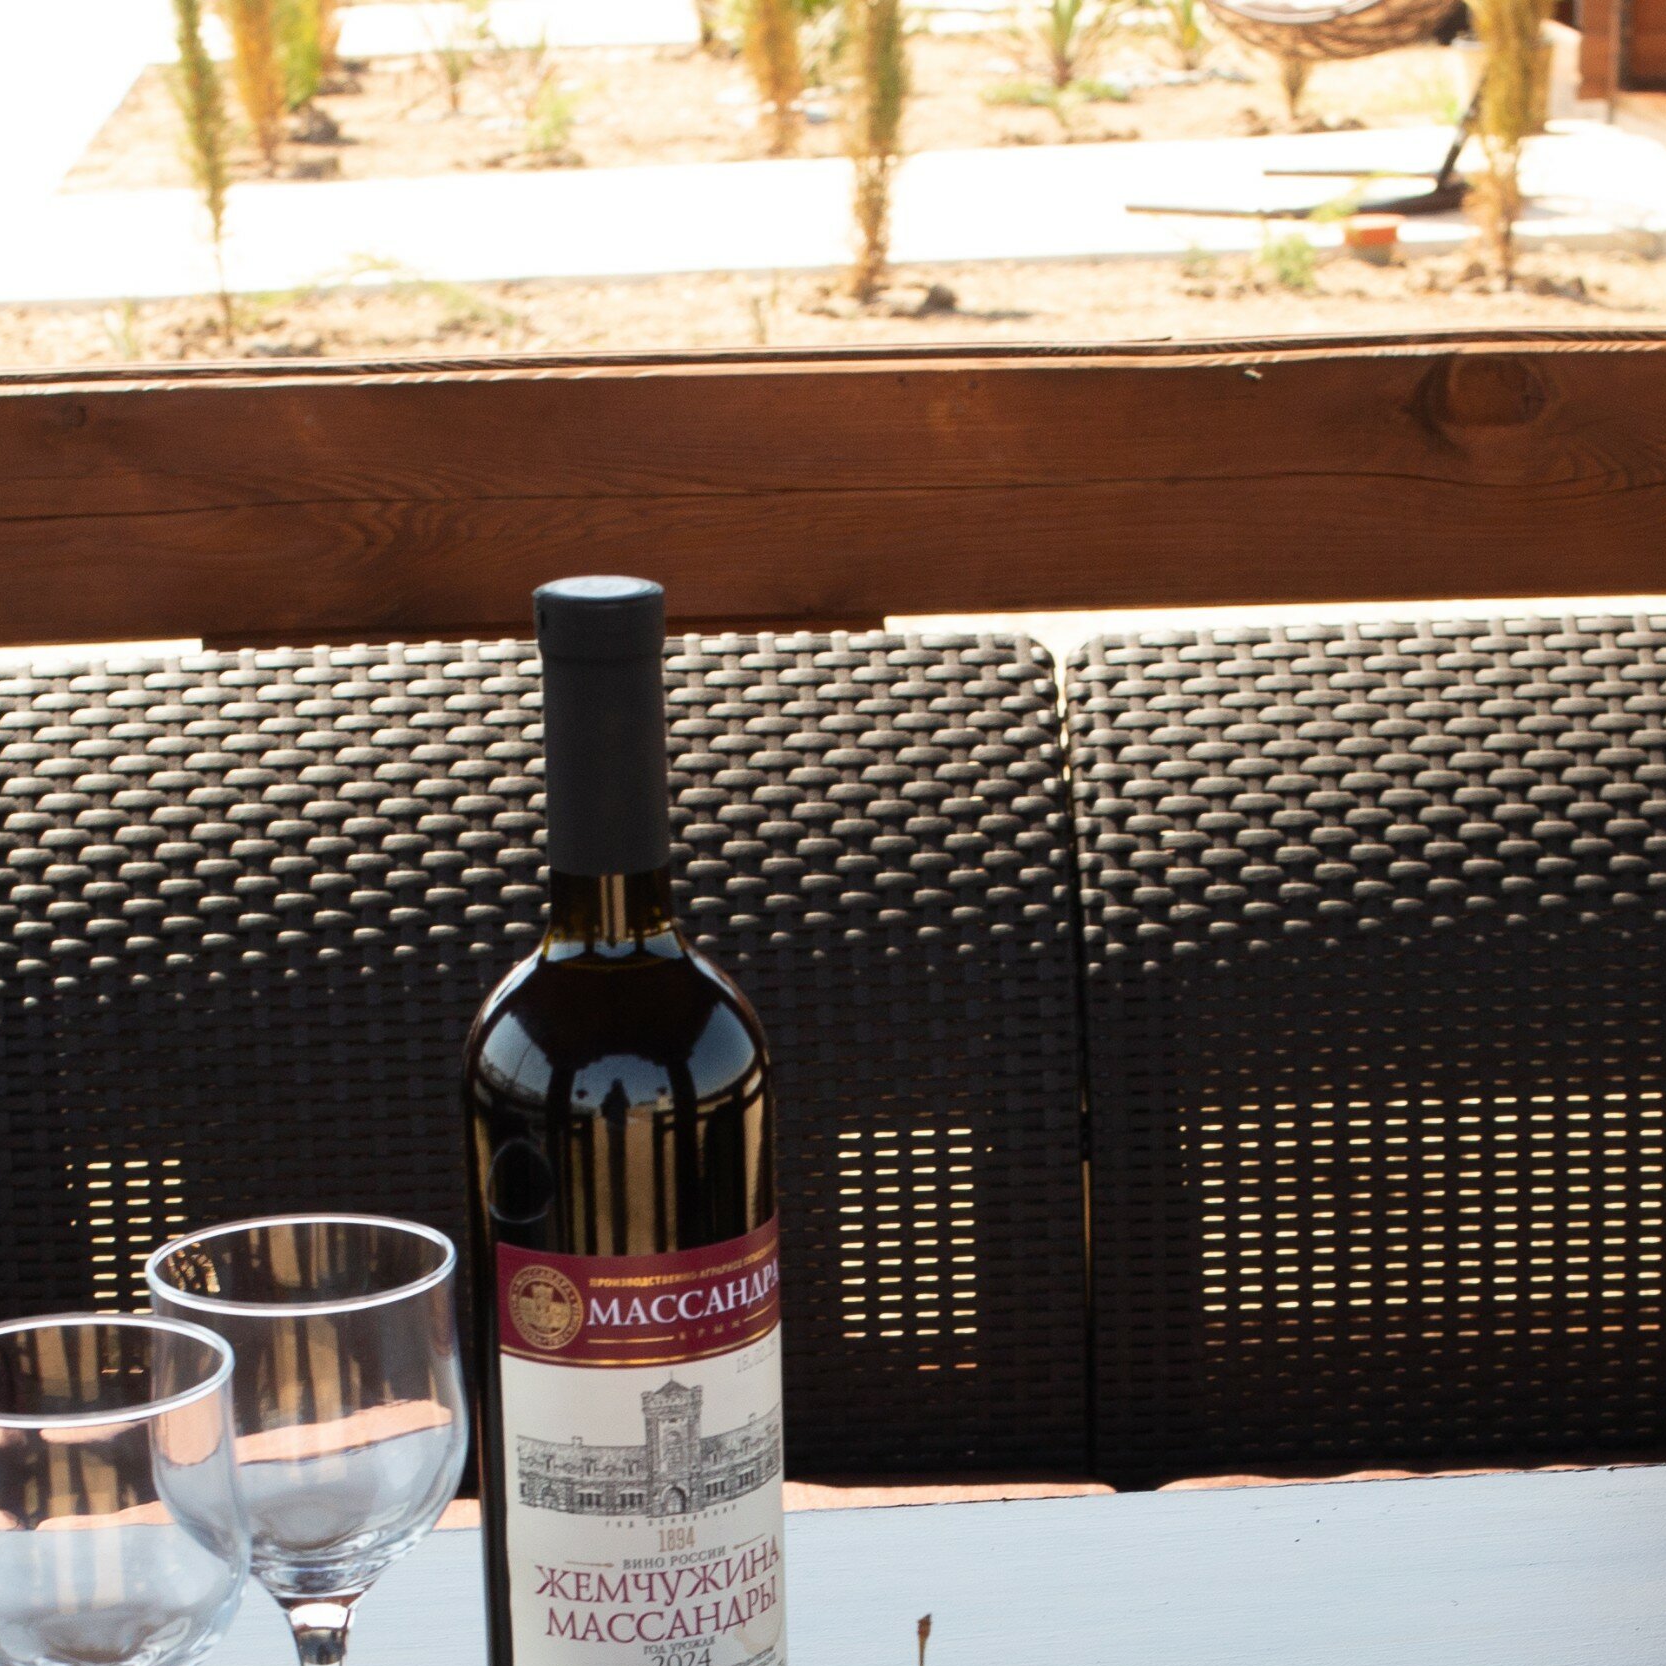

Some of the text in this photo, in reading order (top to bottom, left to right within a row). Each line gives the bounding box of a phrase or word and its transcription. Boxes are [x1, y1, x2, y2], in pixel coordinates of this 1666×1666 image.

[586, 1257, 780, 1327] МАССАНДРА
[622, 1545, 727, 1571] ВИНО РОССИИ
[658, 1526, 696, 1552] 1894
[534, 1534, 780, 1607] ЖЕМЧУЖИНА
[545, 1575, 778, 1644] МАССАНДРЫ
[644, 1644, 666, 1655] ГОД
